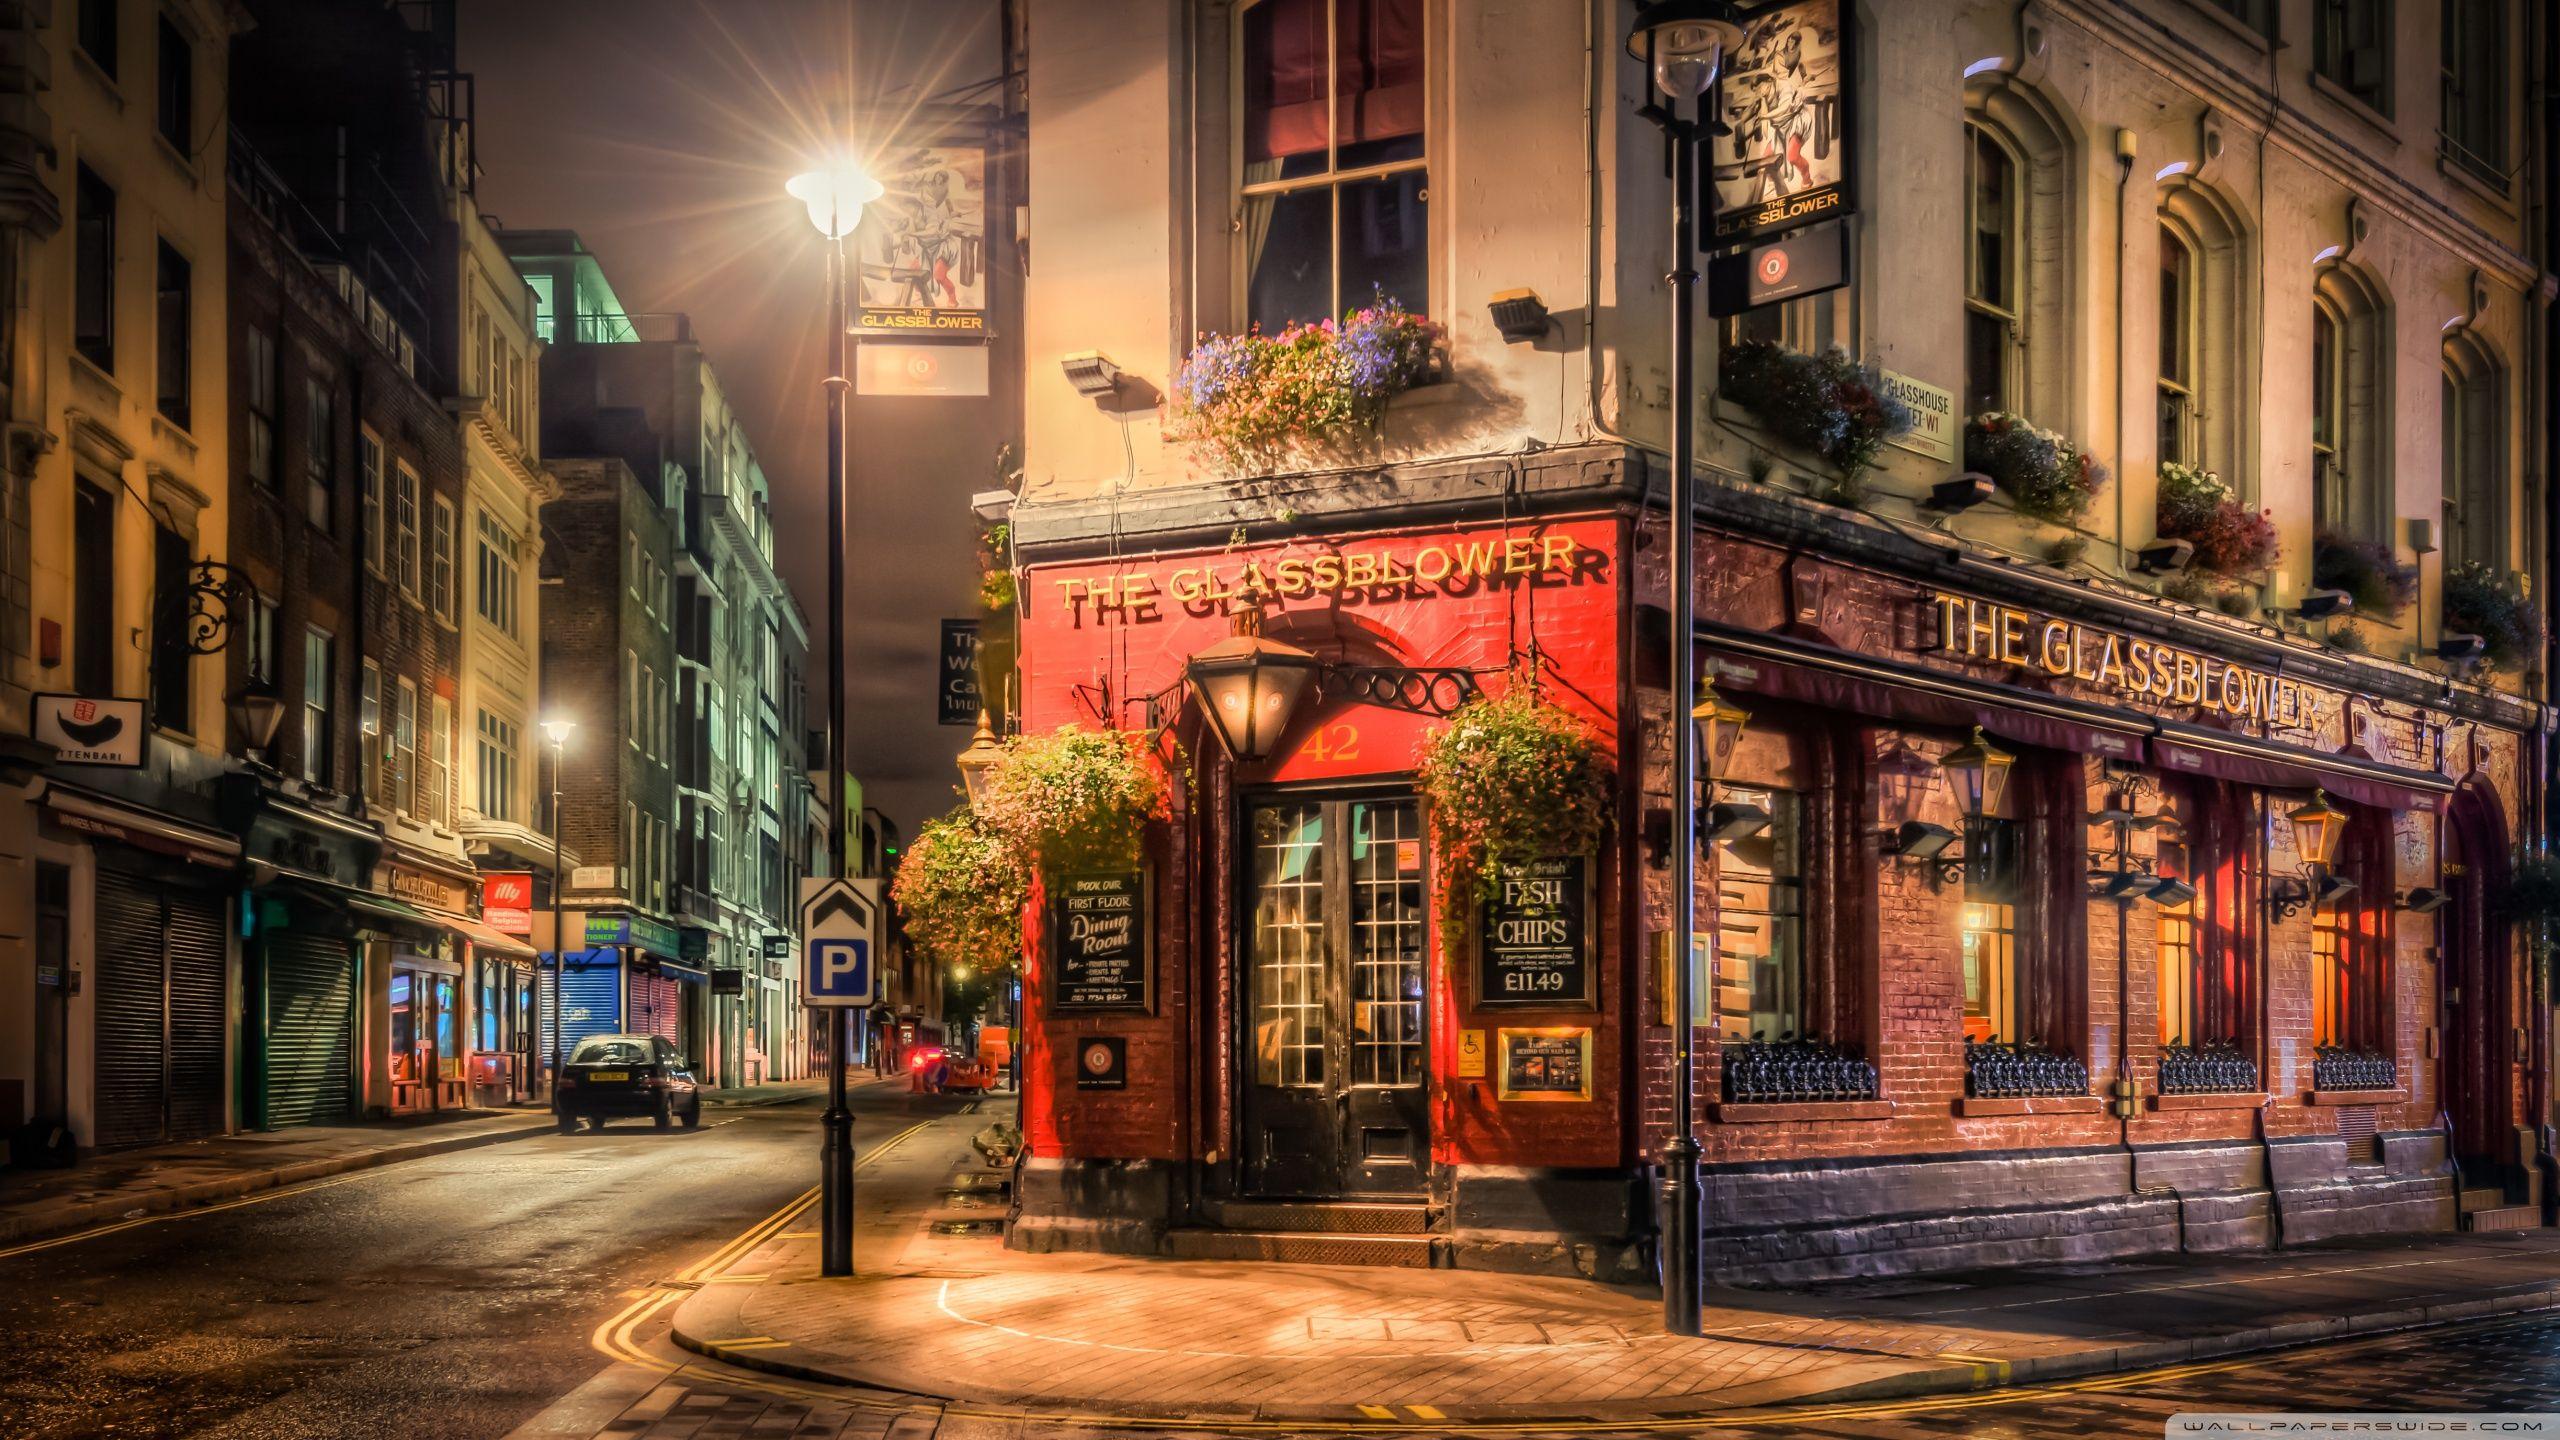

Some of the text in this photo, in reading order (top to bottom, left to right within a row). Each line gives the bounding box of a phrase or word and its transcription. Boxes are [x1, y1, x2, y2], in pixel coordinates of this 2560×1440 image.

[1715, 193, 1839, 236] GLASSBLOWER
[1766, 198, 1786, 211] THE
[861, 315, 983, 329] GLASSBLOWER
[912, 308, 932, 317] THE
[1886, 377, 1949, 415] GLASSHOUSE
[1056, 534, 1578, 610] THE GLASSBLOWER
[952, 632, 977, 648] Th
[1935, 591, 2321, 730] THE GLASSBLOWER
[950, 679, 981, 694] Ca
[1300, 724, 1360, 762] 42
[59, 750, 122, 761] TTENBARI
[494, 882, 521, 903] illy
[1076, 880, 1123, 892] BOOK OUR
[1068, 896, 1132, 910] FIRST FLOOR
[586, 933, 618, 941] TIONERY
[1069, 914, 1133, 941] Dining
[1498, 920, 1567, 944] CHIPS
[1083, 932, 1130, 955] Room
[822, 945, 857, 990] P
[1505, 972, 1564, 991] £11.49
